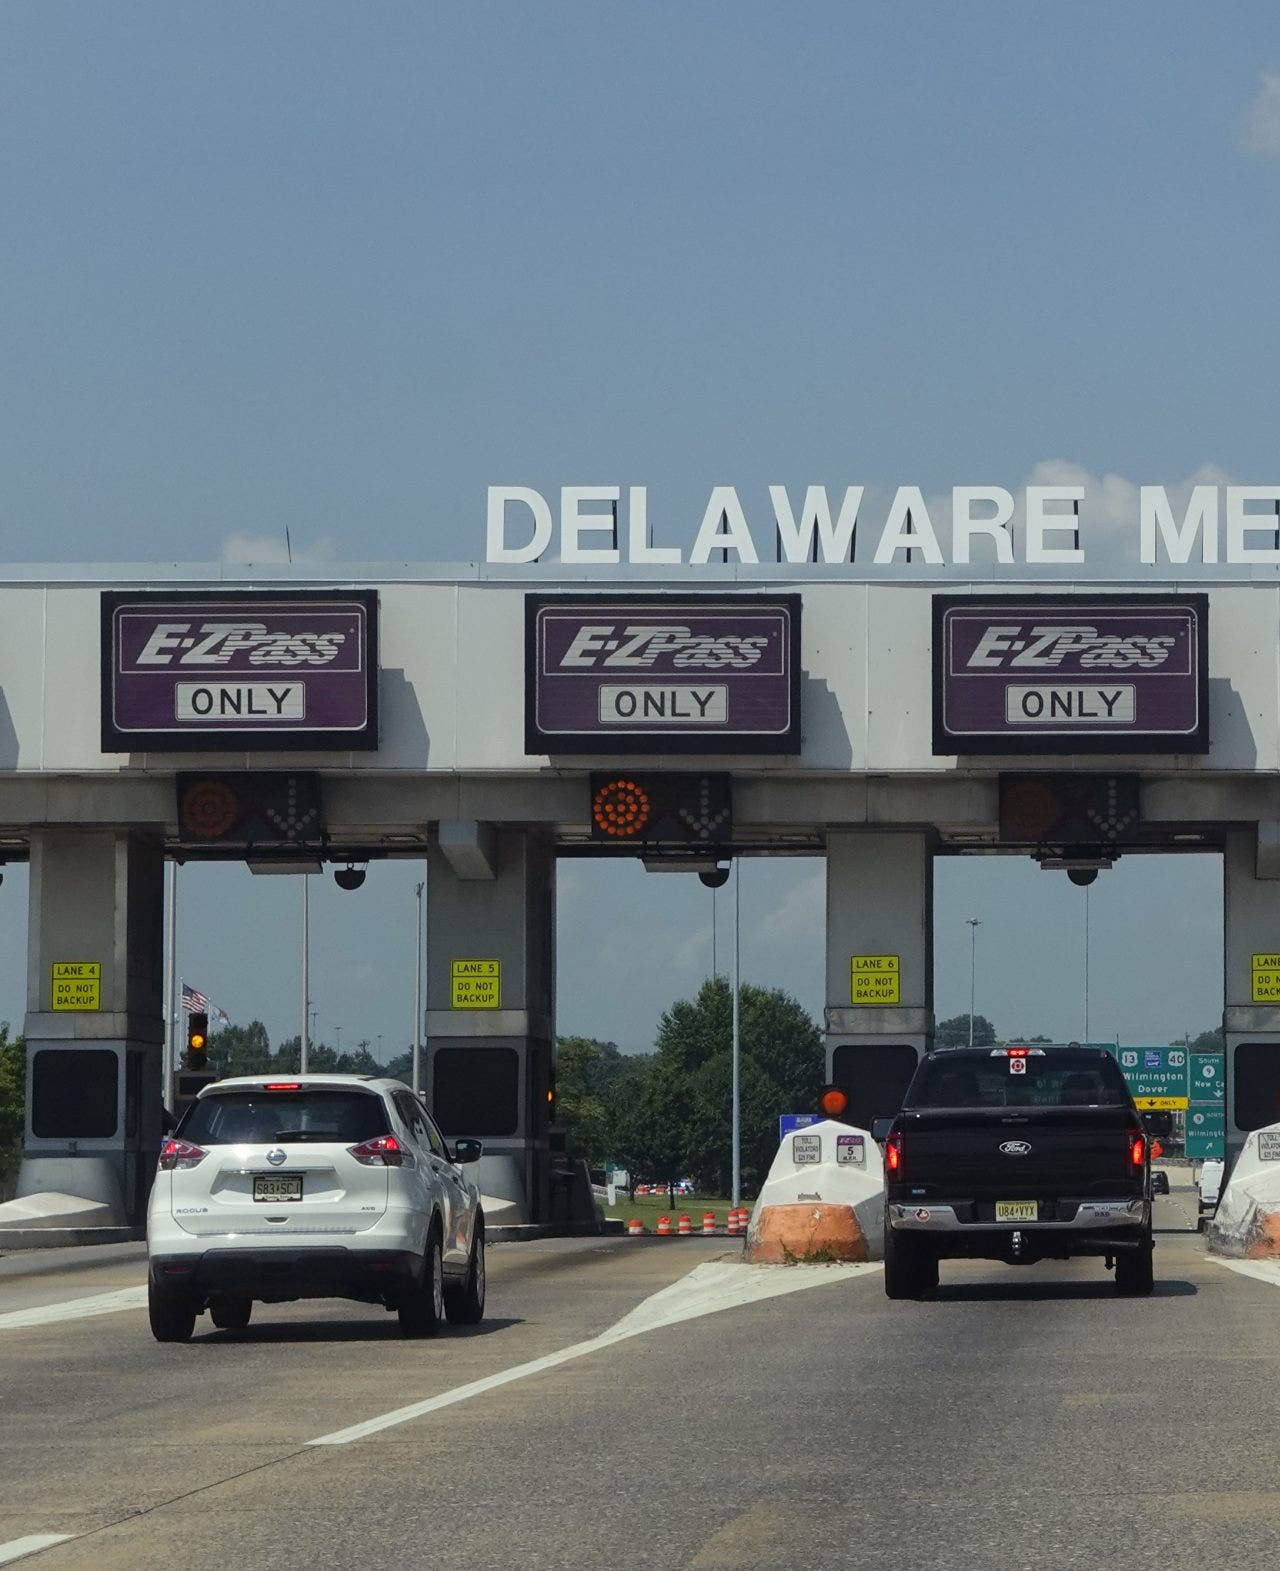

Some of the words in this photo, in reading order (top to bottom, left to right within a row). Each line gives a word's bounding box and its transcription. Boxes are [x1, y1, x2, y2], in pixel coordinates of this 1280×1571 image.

[486, 485, 1086, 564] DELAWARE
[135, 623, 347, 666] E-ZPass
[559, 626, 771, 668] E-ZPass
[966, 626, 1178, 668] E-ZPass
[190, 687, 292, 715] ONLY
[614, 690, 716, 718] ONLY
[1021, 690, 1123, 718] ONLY
[457, 964, 483, 973] LANE
[488, 964, 495, 973] 5
[856, 959, 882, 969] LANE
[888, 960, 894, 968] 6
[57, 966, 83, 975] LANE
[88, 966, 95, 975] 4
[857, 977, 870, 986] DO
[875, 977, 893, 986] NOT
[1258, 975, 1271, 984] DO
[58, 984, 71, 993] DO
[76, 984, 94, 993] NOT
[457, 982, 470, 991] DO
[475, 982, 493, 991] NOT
[856, 989, 895, 998] BACKUP
[57, 996, 95, 1005] BACKUP
[457, 994, 495, 1003] BACKUP
[1124, 1055, 1136, 1064] 13
[1169, 1055, 1184, 1064] 40
[1123, 1072, 1184, 1082] Wilmington
[1194, 1080, 1212, 1088] New
[1138, 1085, 1168, 1093] Dover
[1188, 1130, 1225, 1138] Wilmingto
[847, 1146, 854, 1156] 5
